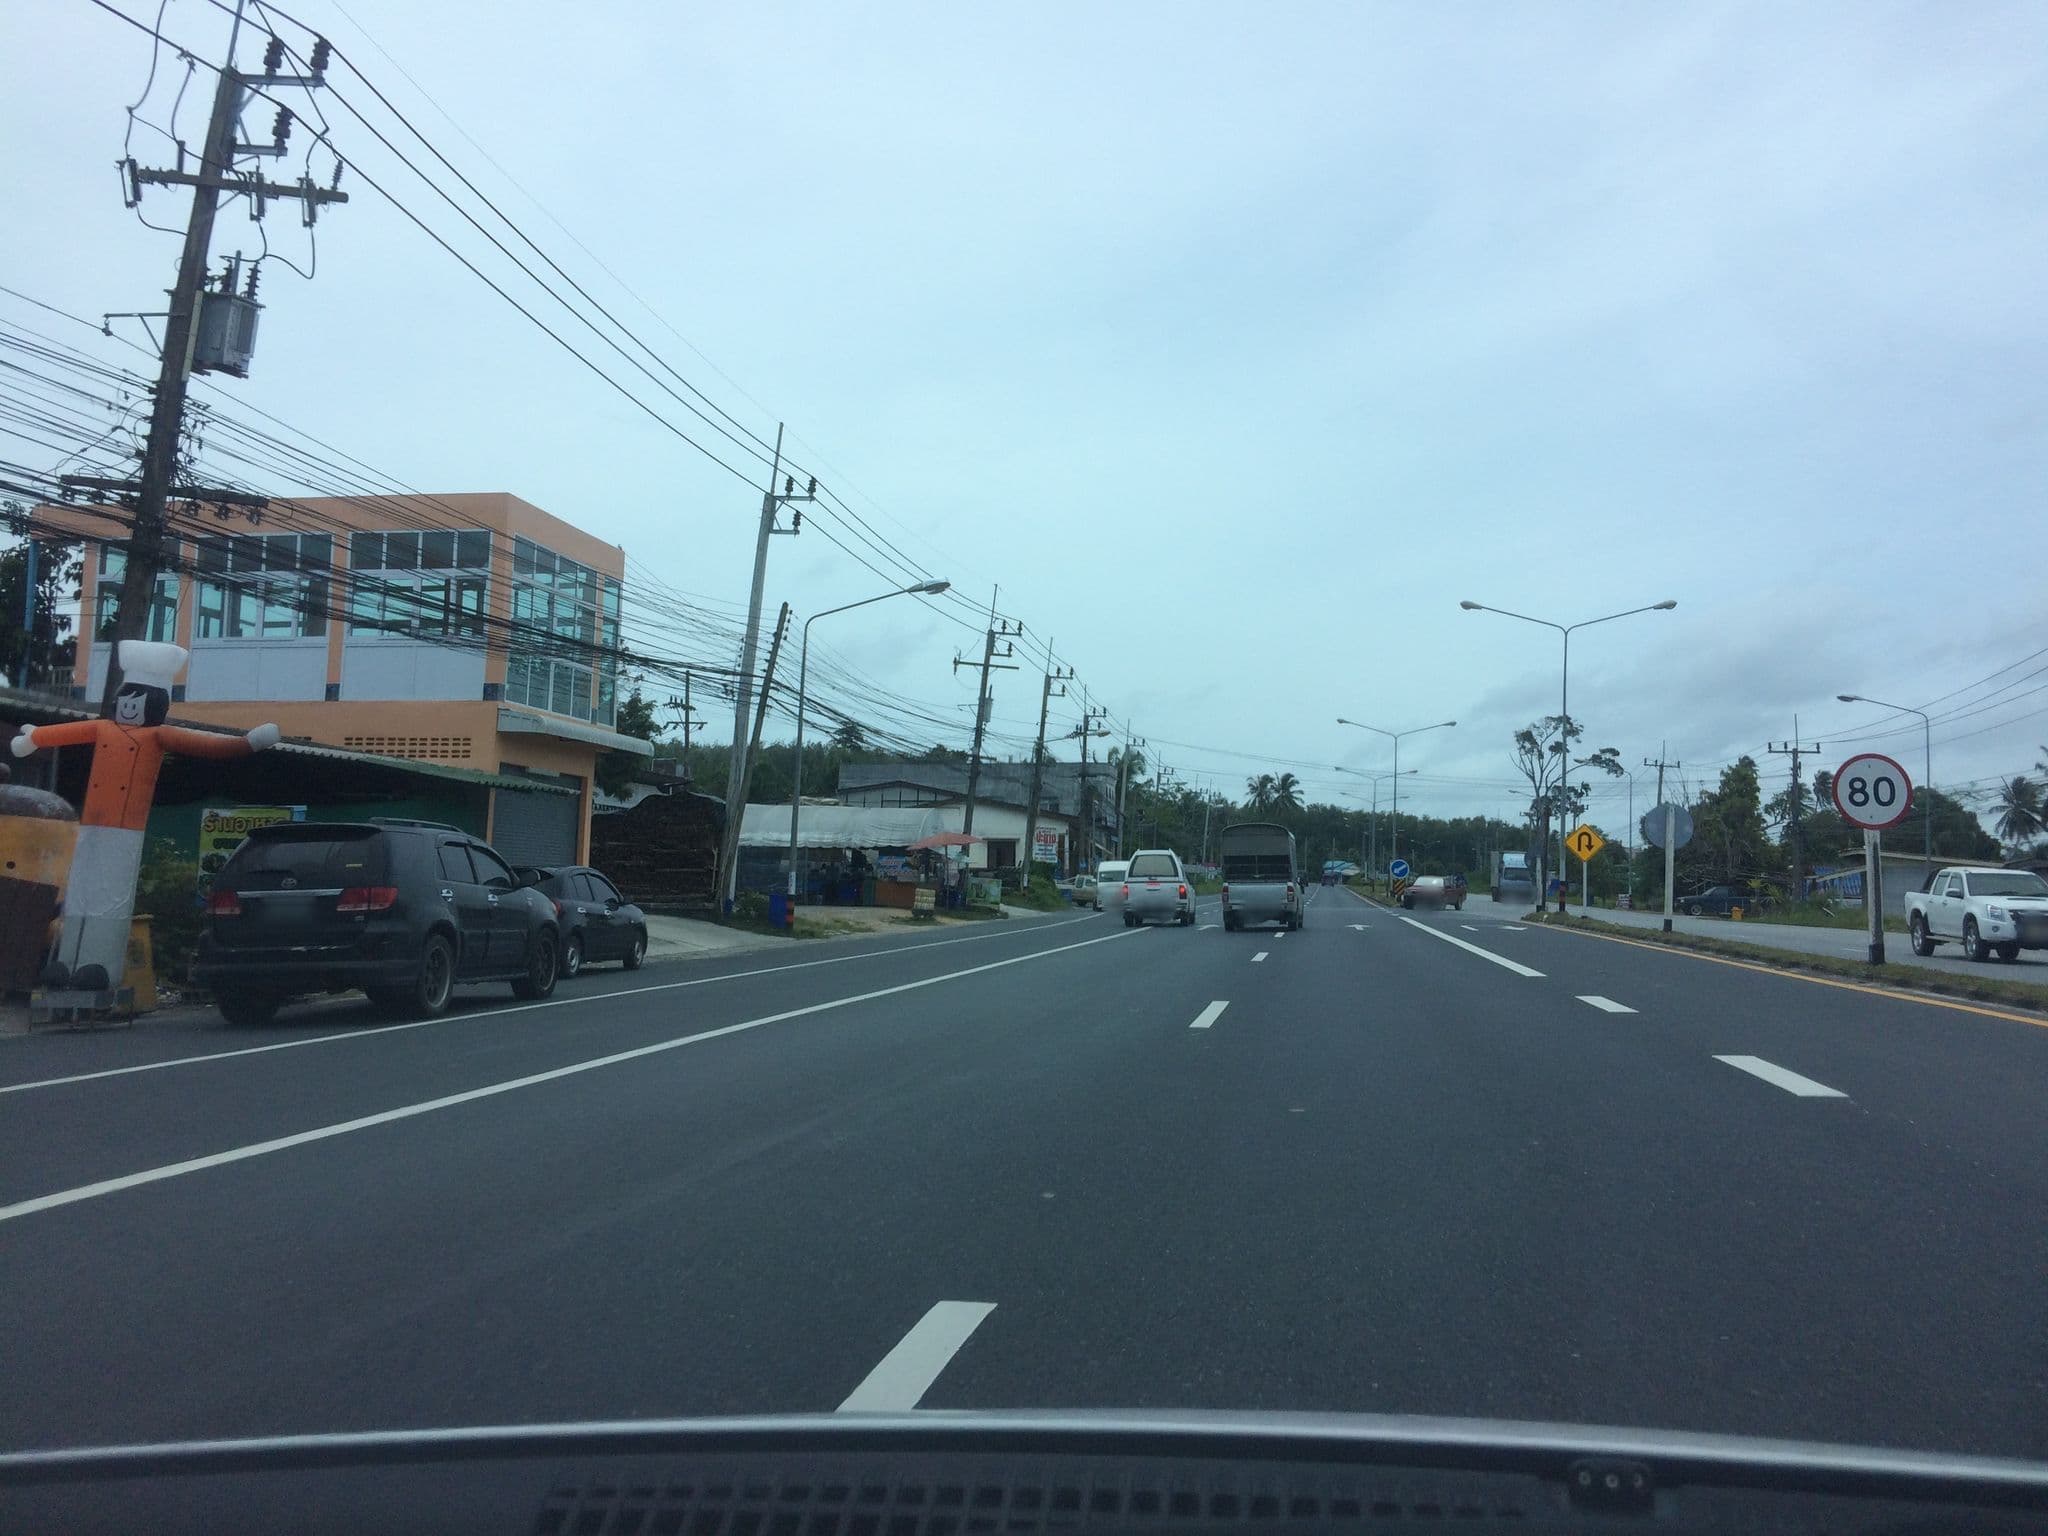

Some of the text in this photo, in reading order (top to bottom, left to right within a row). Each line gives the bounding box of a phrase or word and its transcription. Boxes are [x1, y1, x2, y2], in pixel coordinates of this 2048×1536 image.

[1848, 776, 1896, 807] 80
[203, 811, 289, 833] ร้านอาหา
